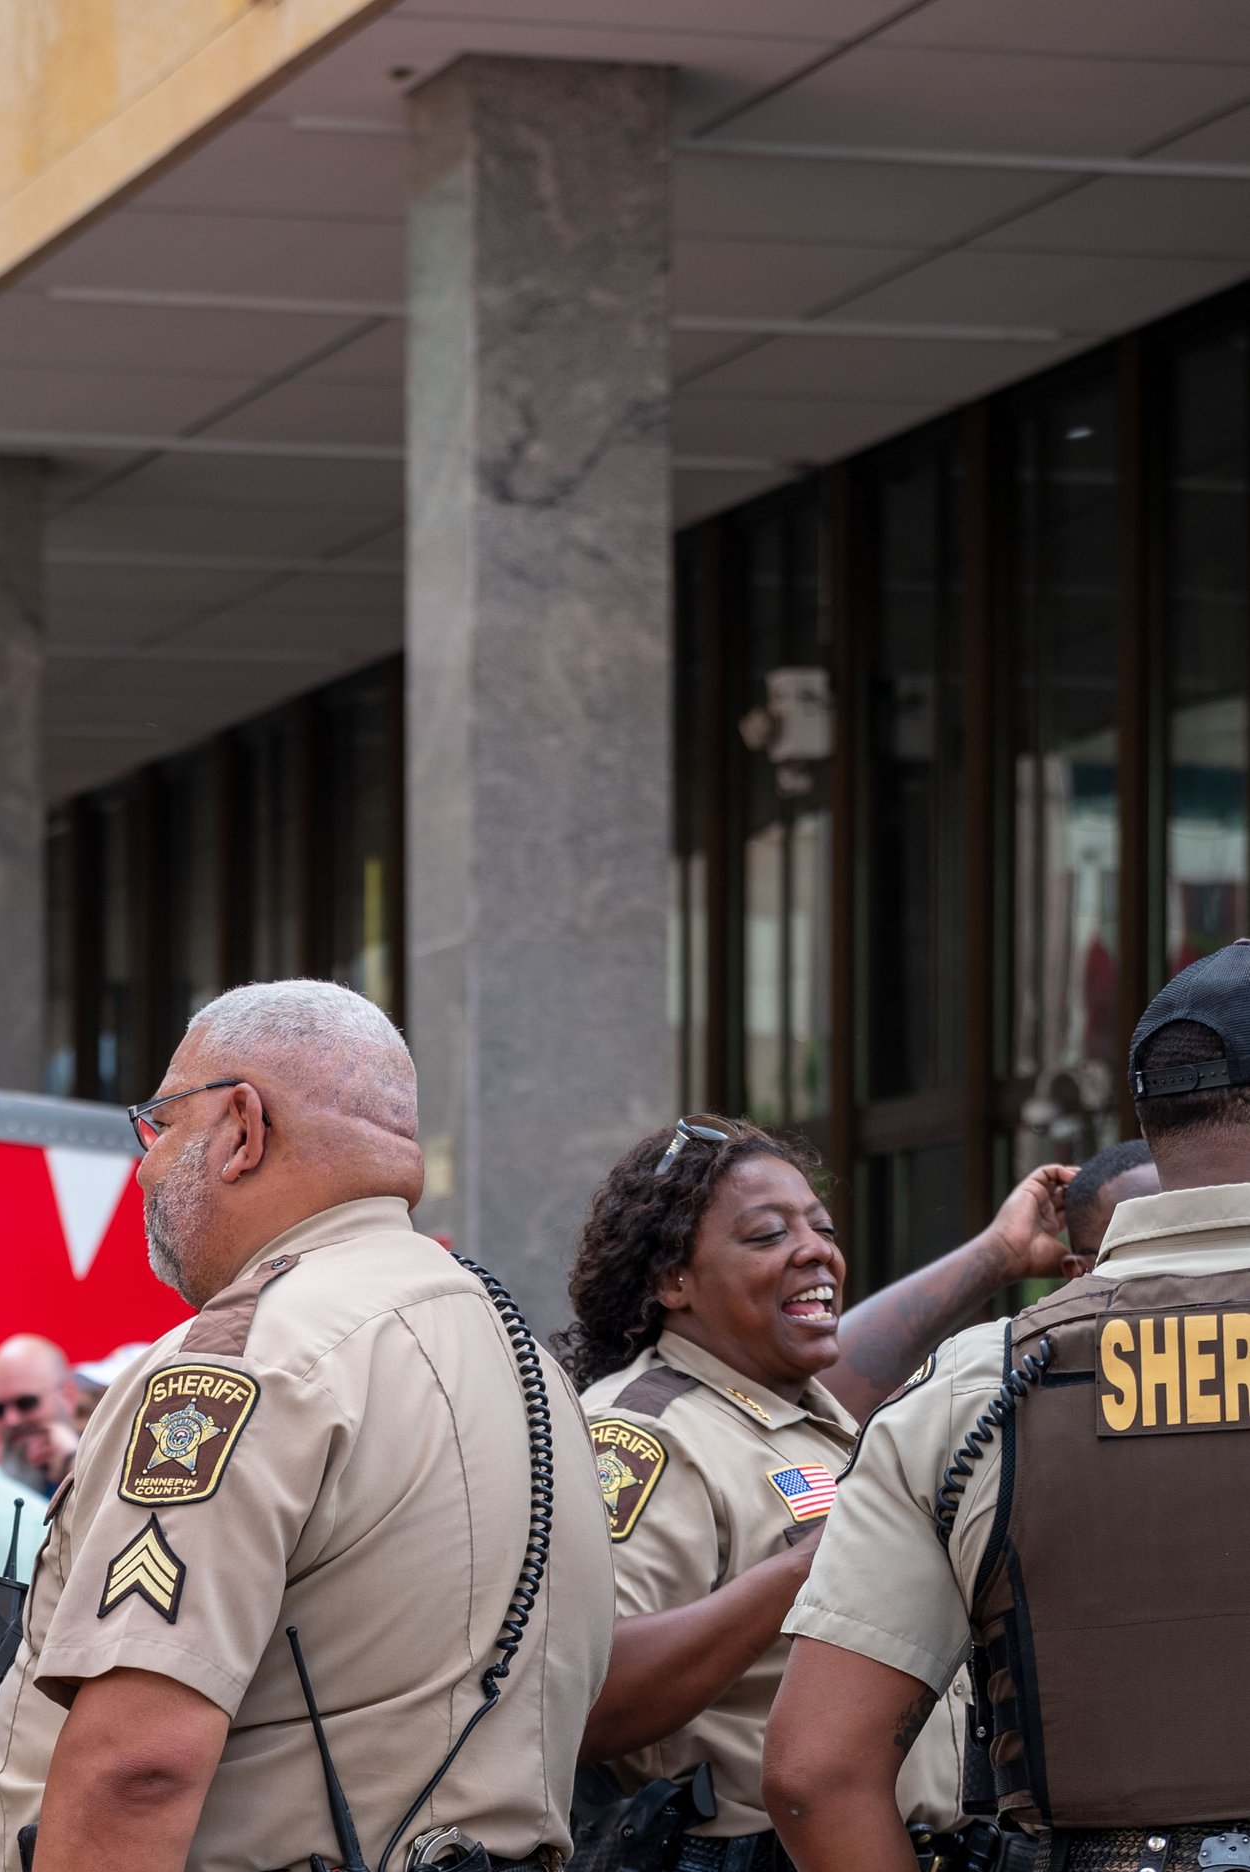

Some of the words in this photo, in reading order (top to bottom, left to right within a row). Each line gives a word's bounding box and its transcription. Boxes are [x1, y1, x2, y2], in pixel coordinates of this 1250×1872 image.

[153, 1375, 249, 1405] SHERIFF
[134, 1477, 198, 1488] HENNEPIN
[135, 1486, 193, 1495] COUNTY
